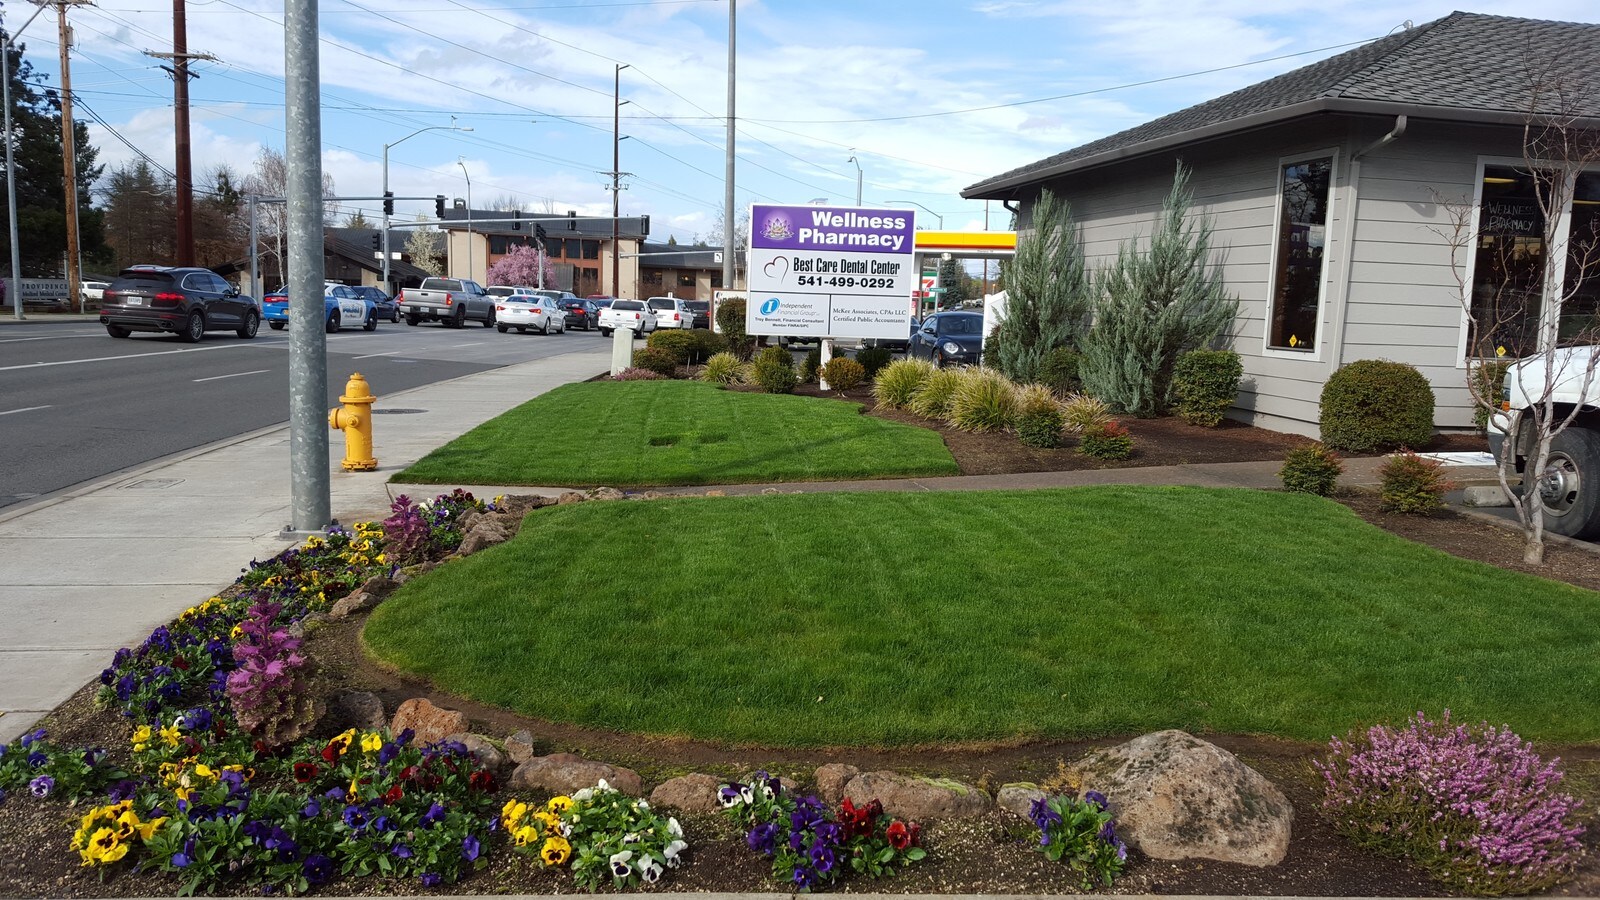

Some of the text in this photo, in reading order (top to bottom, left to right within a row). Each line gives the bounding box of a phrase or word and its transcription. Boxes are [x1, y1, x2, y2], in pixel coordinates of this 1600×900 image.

[812, 210, 906, 230] Wellness
[799, 227, 905, 250] Pharmacy
[793, 257, 900, 275] Best Care Dental Center
[798, 275, 894, 288] 541-499-0292
[780, 302, 813, 310] Independent
